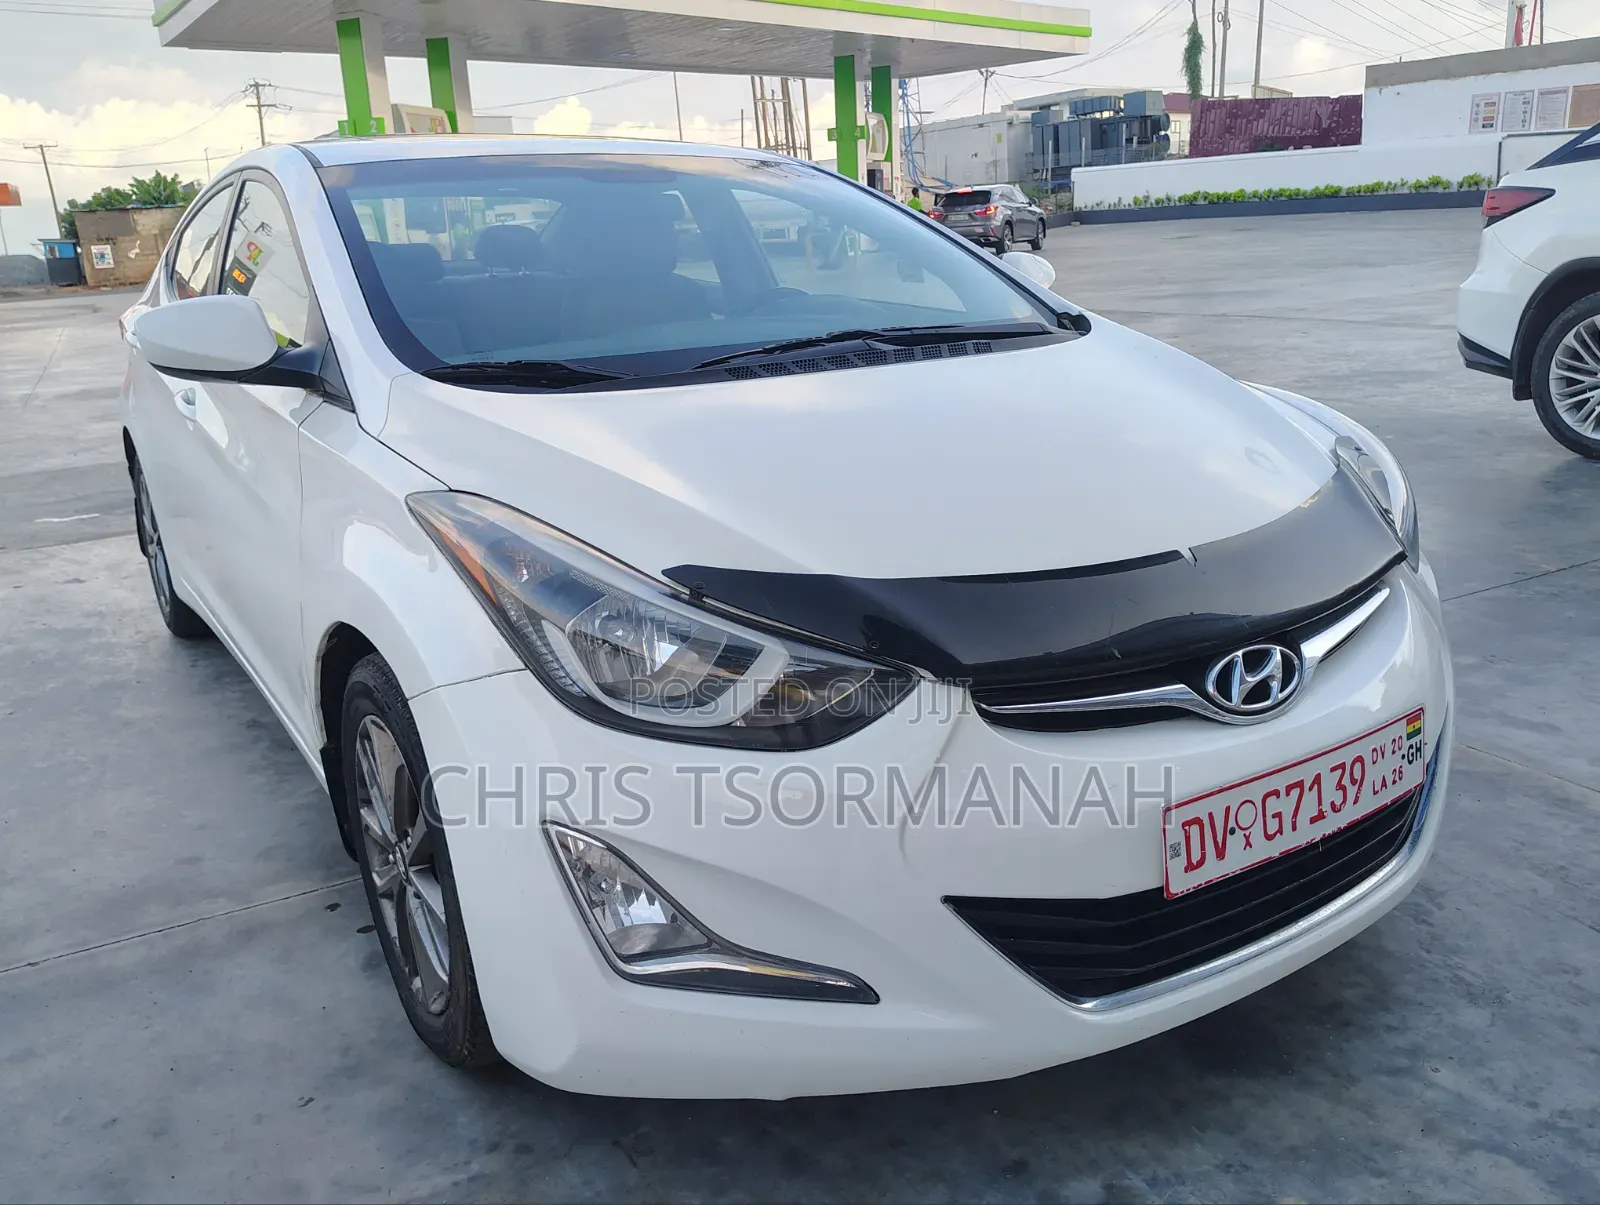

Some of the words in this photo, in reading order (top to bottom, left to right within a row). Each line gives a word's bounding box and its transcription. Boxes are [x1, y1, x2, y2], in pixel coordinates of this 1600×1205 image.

[369, 120, 378, 133] 2
[1371, 743, 1386, 765] DV
[1391, 735, 1403, 755] 20
[1406, 739, 1422, 765] GH
[1372, 774, 1387, 796] LA
[1391, 764, 1404, 785] 26
[1181, 804, 1231, 874] DV
[1261, 754, 1366, 842] G7139
